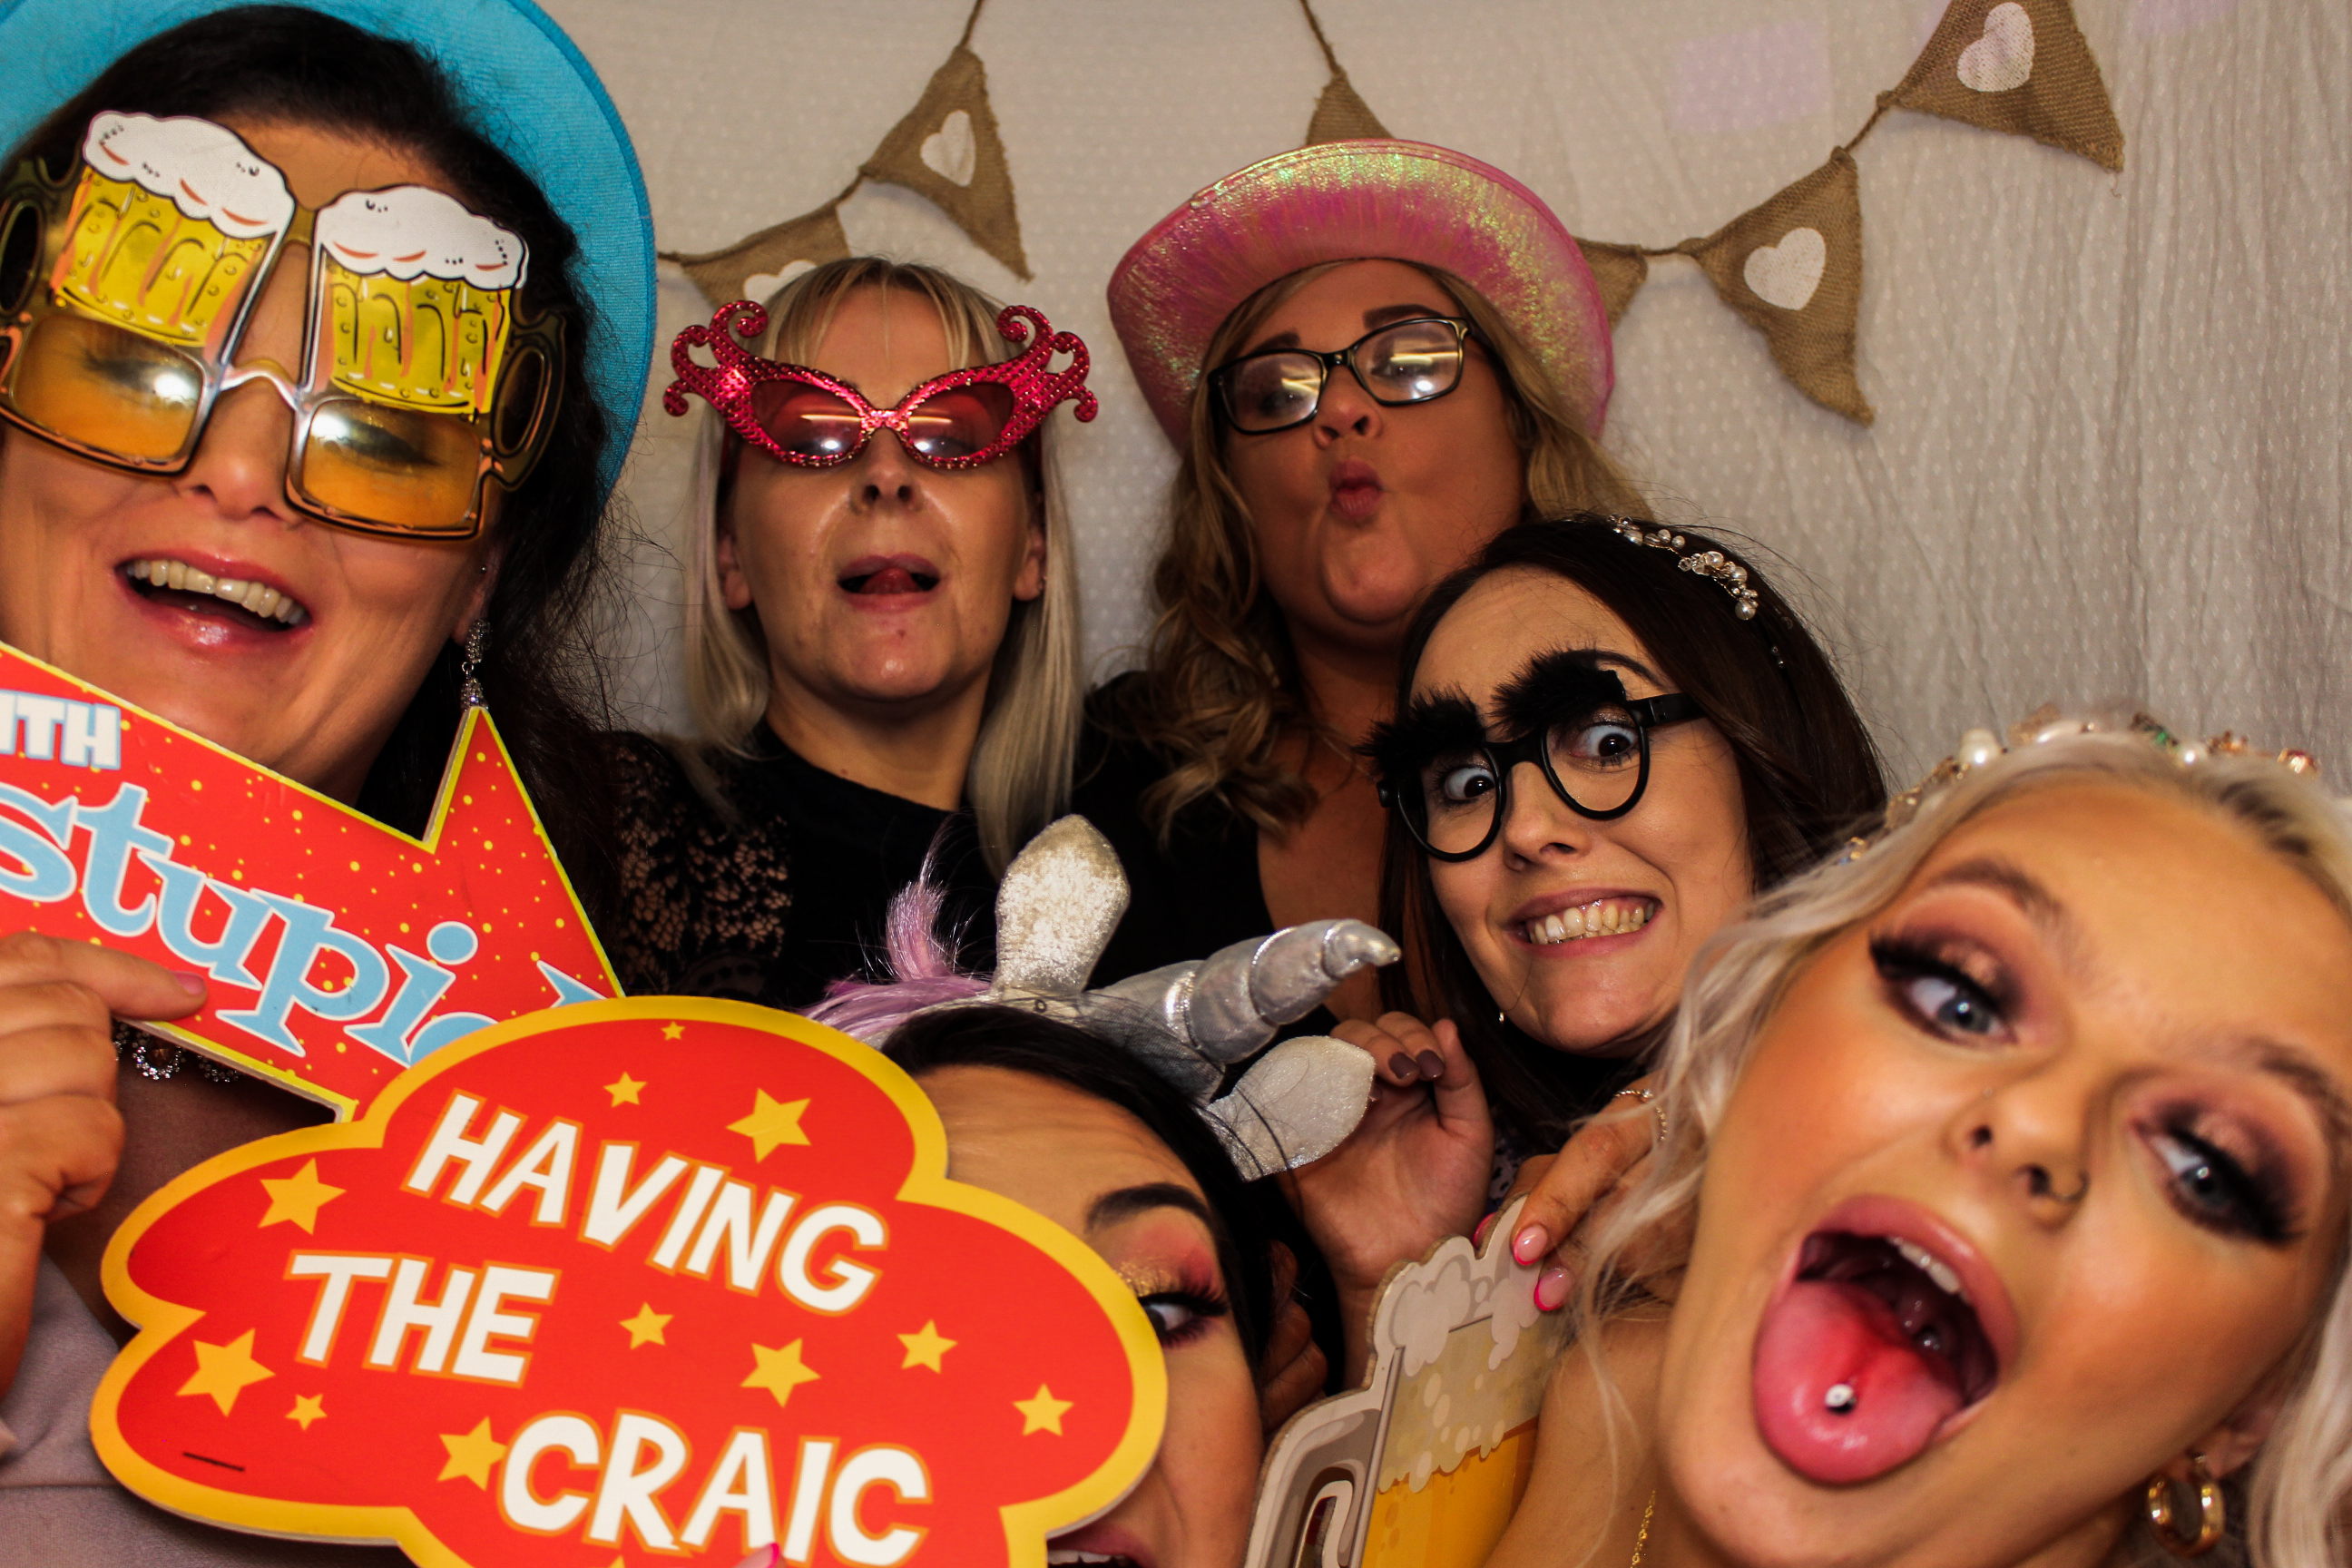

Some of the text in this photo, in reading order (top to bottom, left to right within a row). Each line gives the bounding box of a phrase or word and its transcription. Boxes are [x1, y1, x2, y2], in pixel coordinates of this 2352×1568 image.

[407, 1094, 887, 1312] HAVING
[289, 1255, 556, 1384] THE
[501, 1412, 928, 1567] CRAIC
